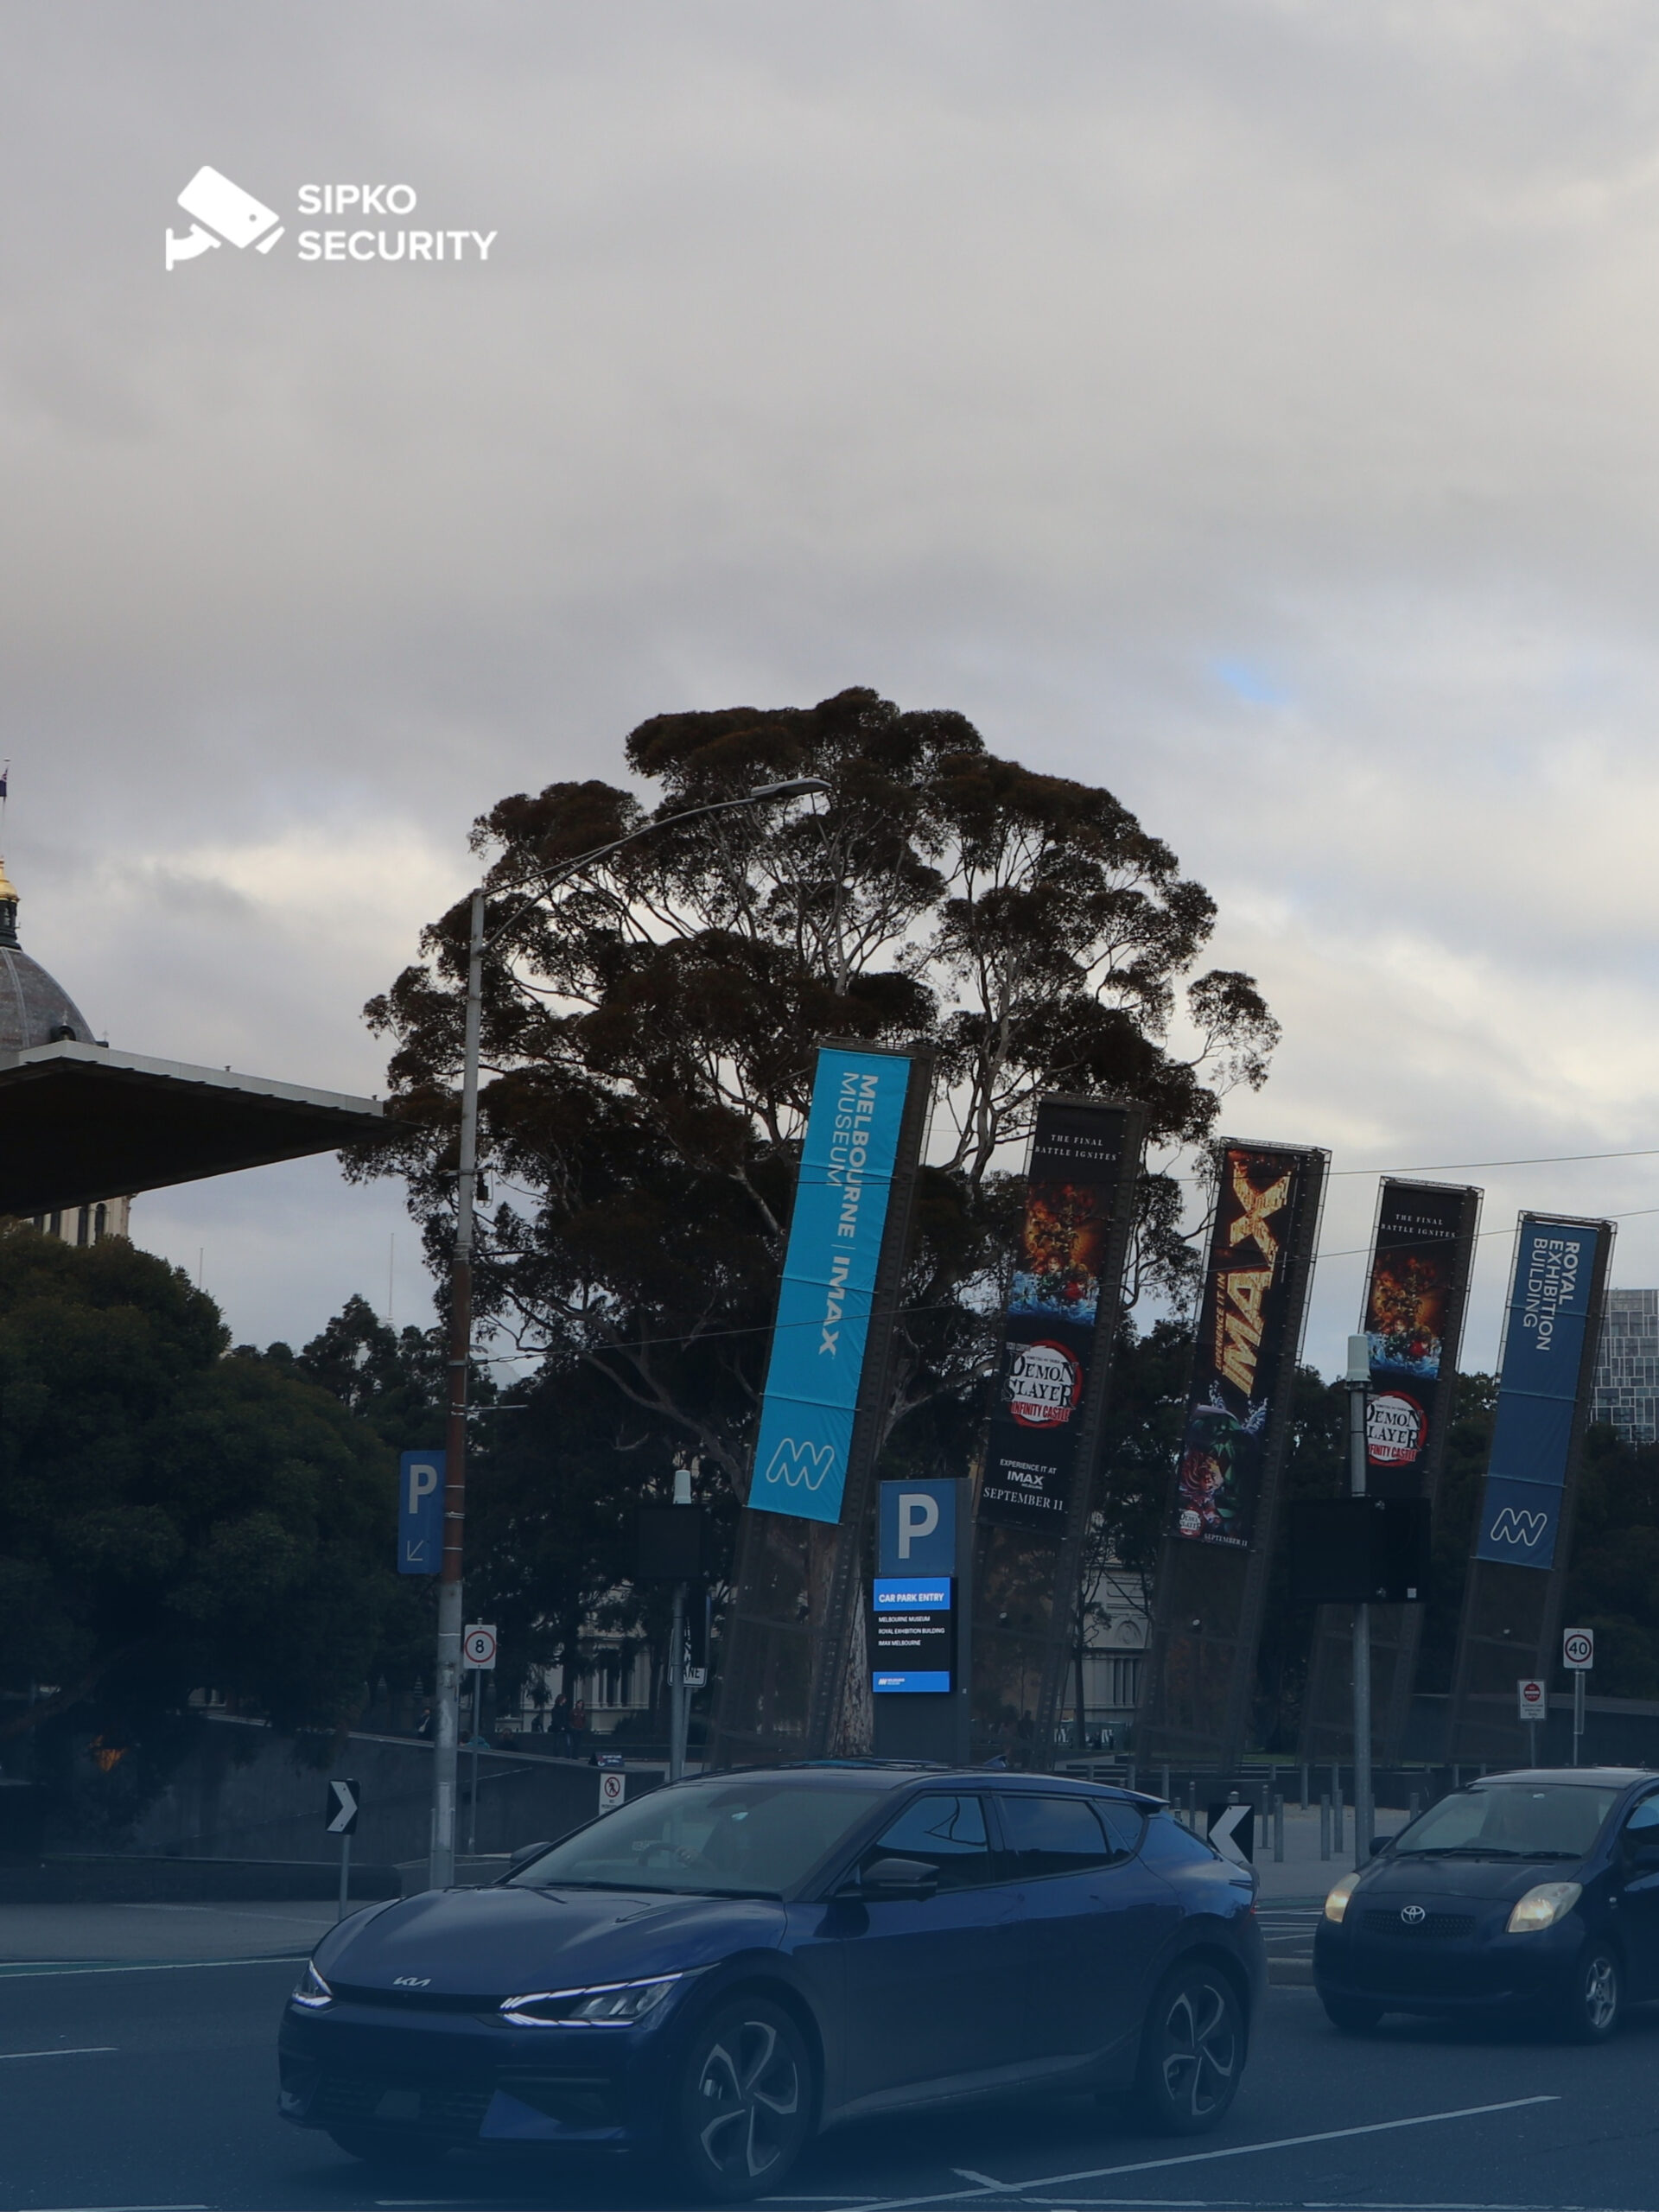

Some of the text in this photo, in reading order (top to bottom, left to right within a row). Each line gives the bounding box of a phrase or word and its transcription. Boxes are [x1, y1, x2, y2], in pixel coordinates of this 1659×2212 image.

[826, 1071, 860, 1187] MUSEUM
[1051, 1134, 1103, 1147] THE FINAL
[1034, 1146, 1116, 1161] BATTLE IGNITES
[817, 1074, 879, 1356] MELBOURNE IMAX
[1395, 1213, 1443, 1226] THE FINAL
[1381, 1224, 1456, 1238] BATTLE IGNITES
[1221, 1160, 1291, 1397] IMAX
[1522, 1237, 1548, 1328] BUILDING
[1559, 1241, 1580, 1305] ROYAL
[1535, 1239, 1564, 1351] EXHIBITION
[1215, 1271, 1226, 1370] EXPERIENCE IT IN
[1007, 1351, 1077, 1385] DEMON
[1002, 1378, 1075, 1409] SLAYER
[1011, 1401, 1071, 1421] INFINITY CASTLE
[1368, 1426, 1421, 1451] LAYER
[1000, 1459, 1040, 1471] EXPERIENCE
[408, 1464, 437, 1514] P
[1007, 1471, 1044, 1485] IMAX
[983, 1486, 1050, 1509] SEPTEMBER
[899, 1493, 939, 1559] P
[878, 1592, 944, 1603] CAR PARK ENTRY
[475, 1639, 485, 1654] 8
[1569, 1642, 1588, 1655] 40
